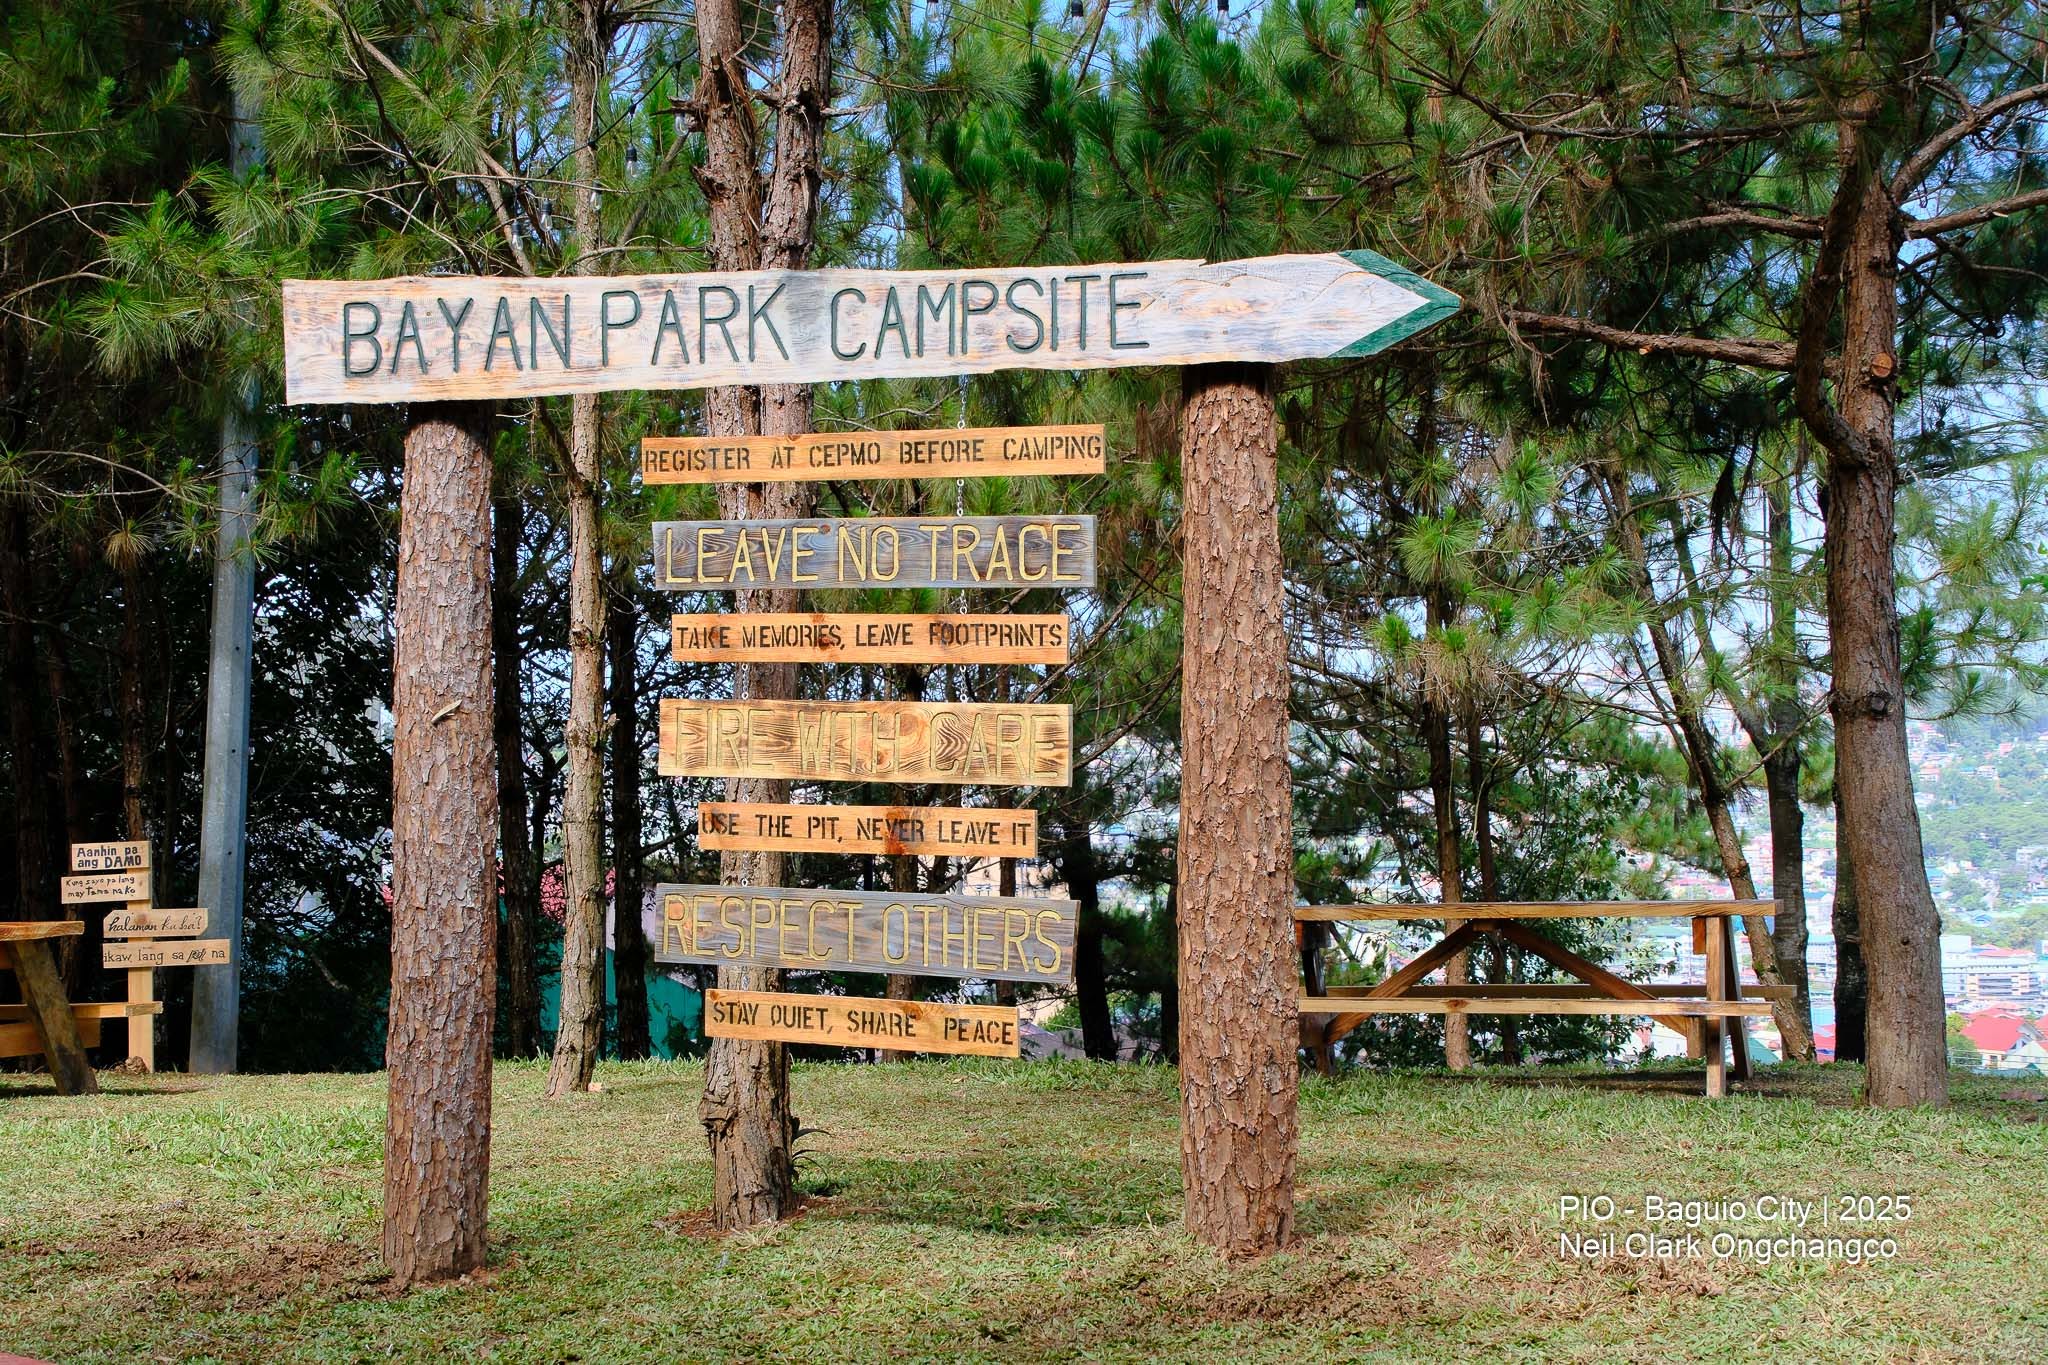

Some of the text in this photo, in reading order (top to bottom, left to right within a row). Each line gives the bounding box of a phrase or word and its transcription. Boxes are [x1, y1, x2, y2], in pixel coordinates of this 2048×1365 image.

[343, 271, 1150, 378] BAYAN PARK CAMPSITE
[644, 434, 1101, 473] REGISTER AT CEPMO BEFORE CAMPING
[665, 523, 1082, 584] LEAVE NO TRACE
[676, 622, 1062, 650] TAKE MEMORIES, LEAVE FOOTPRINTS
[675, 707, 1061, 778] FIRE WITH CARE
[702, 813, 1032, 846] USE THE PIT, NEVER LEAVE IT
[77, 845, 138, 857] Aanhin pa
[78, 855, 142, 868] ang DAMO
[108, 915, 157, 932] halaman
[662, 894, 1063, 974] RESPECT OTHERS
[103, 951, 132, 963] ikaw
[138, 949, 164, 965] lang
[172, 952, 184, 960] sa
[211, 950, 225, 958] na
[713, 1001, 759, 1025] STAY
[847, 1010, 917, 1038] SHARE
[944, 1018, 1014, 1045] PEACE
